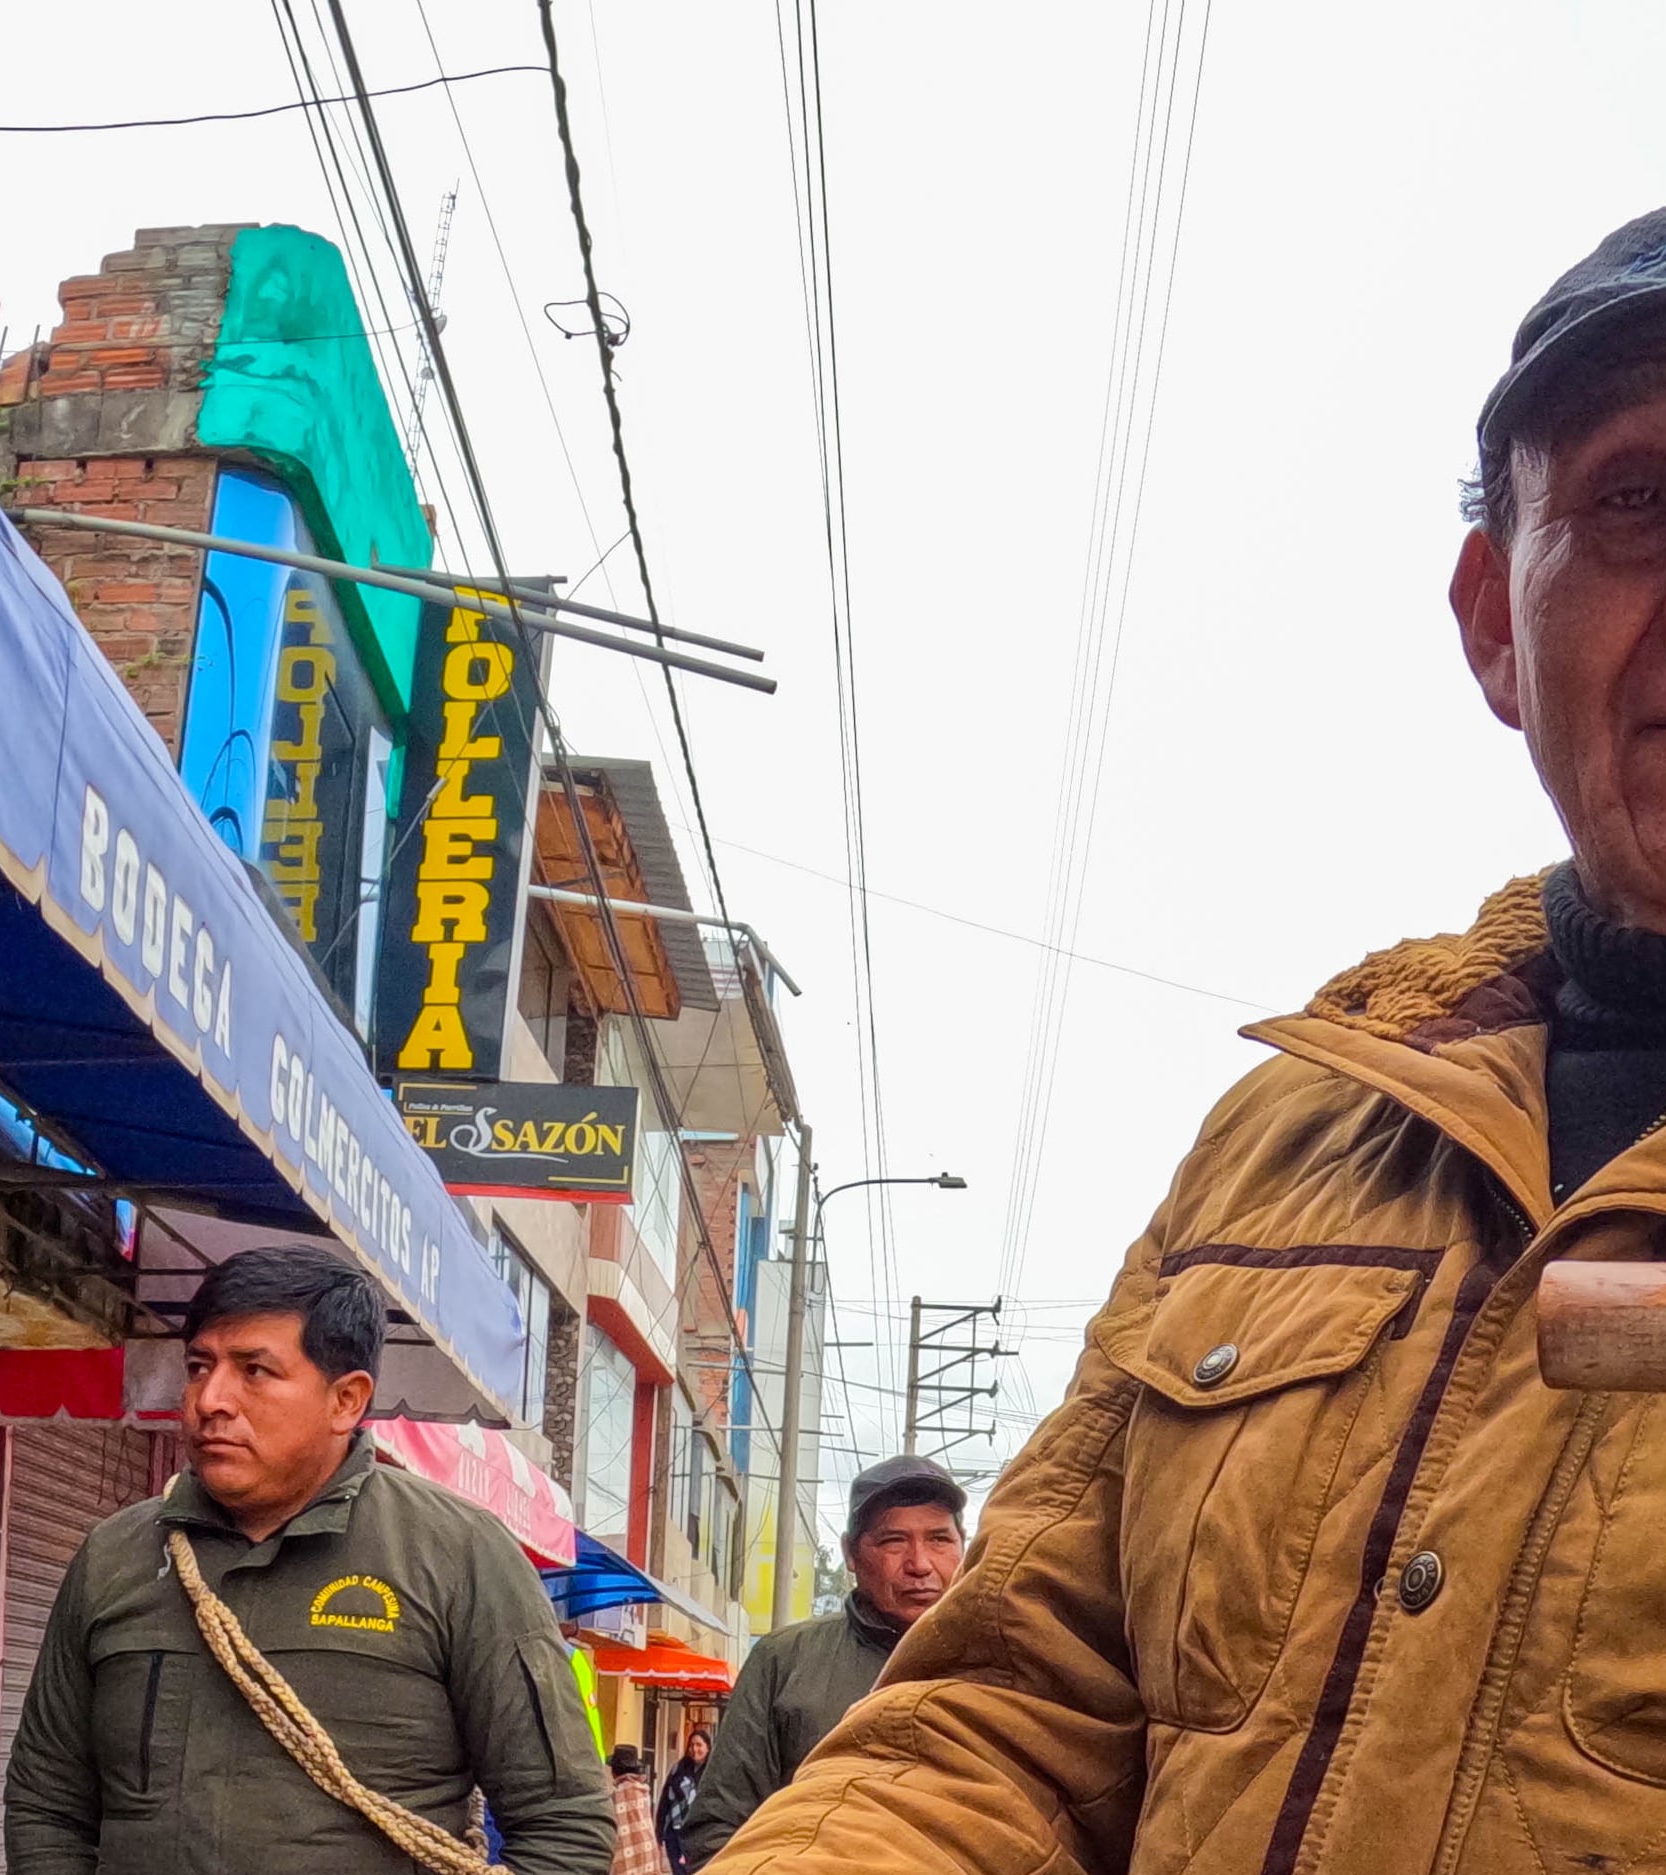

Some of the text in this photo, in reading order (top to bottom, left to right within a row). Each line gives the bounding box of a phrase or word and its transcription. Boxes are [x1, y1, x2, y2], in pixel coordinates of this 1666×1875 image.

[80, 783, 232, 1060] BODEGA
[310, 1574, 359, 1613] COMUNIDAD
[310, 1613, 395, 1633] SAPALLANGA
